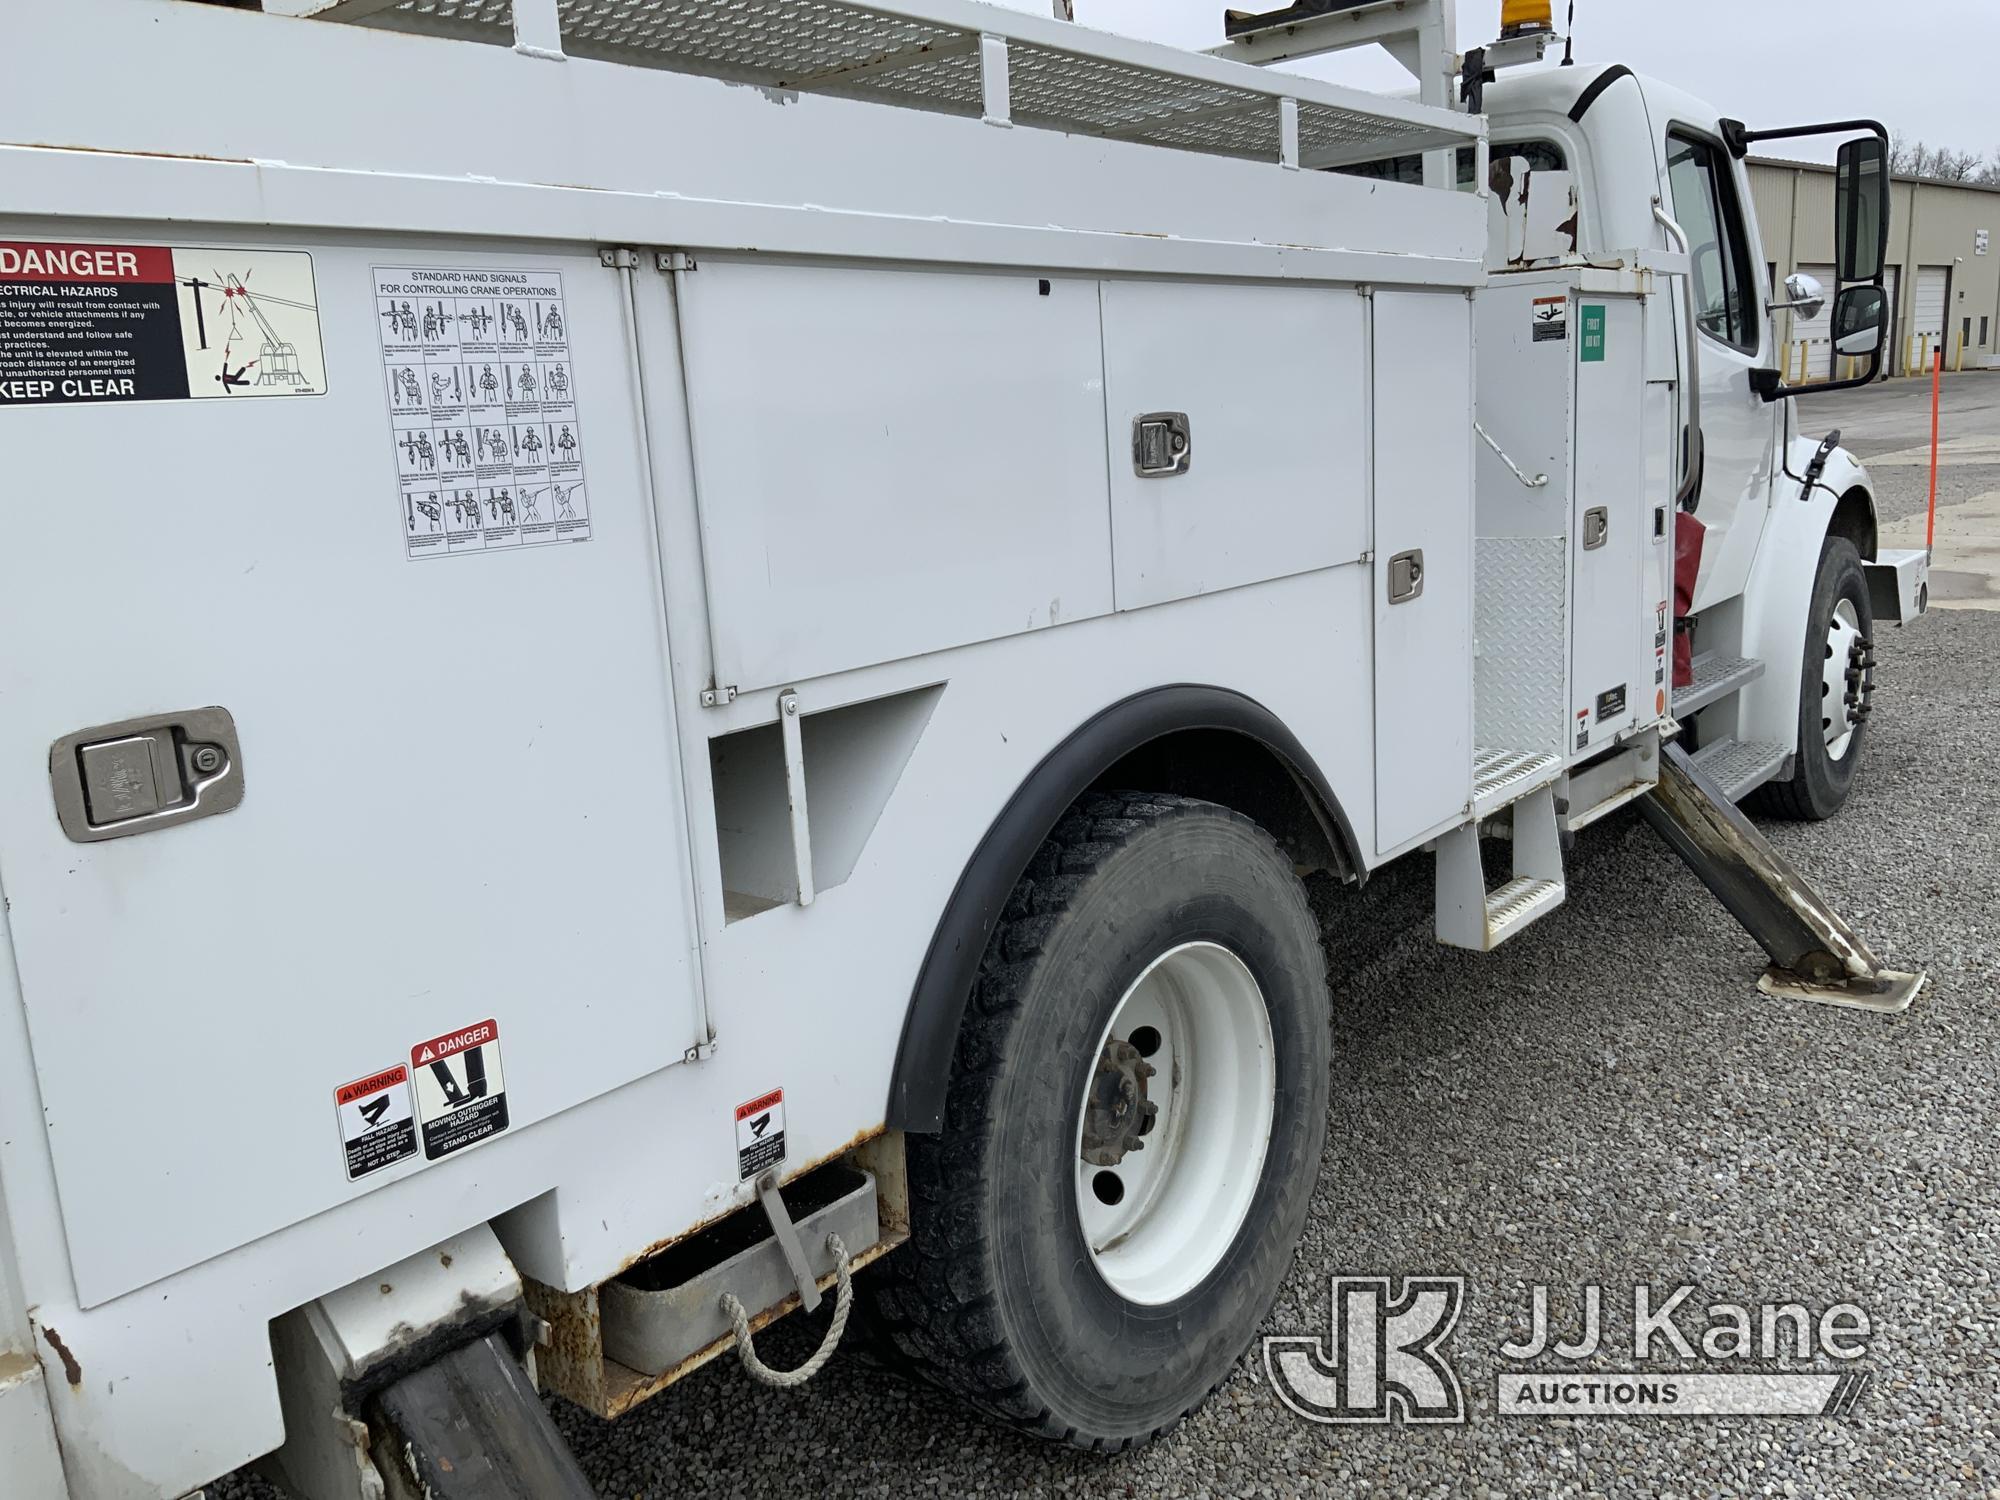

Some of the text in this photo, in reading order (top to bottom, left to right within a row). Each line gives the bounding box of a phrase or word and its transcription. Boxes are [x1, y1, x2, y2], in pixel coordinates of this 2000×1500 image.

[0, 248, 139, 276] DANGER
[411, 272, 527, 283] STANDARD HAND SIGNALS
[60, 286, 118, 297] HAZARDS
[380, 284, 557, 296] FOR CONTROLLING CRANE OPERATIONS
[9, 301, 36, 310] injury
[39, 301, 55, 309] will
[57, 301, 84, 309] result
[86, 301, 106, 309] from
[31, 310, 63, 318] vehicle
[65, 311, 120, 319] attachments
[130, 312, 145, 320] any
[48, 320, 95, 329] energized.
[13, 331, 65, 339] understand
[67, 331, 84, 339] and
[86, 331, 112, 339] follow
[114, 331, 133, 339] safe
[4, 341, 50, 351] practices.
[46, 350, 84, 358] elevated
[27, 360, 67, 368] distance
[68, 359, 77, 367] of
[93, 358, 136, 368] energized
[5, 369, 66, 377] unauthorized
[68, 368, 112, 378] personnel
[0, 379, 135, 399] KEEP CLEAR
[438, 1026, 490, 1055] DANGER
[352, 1070, 403, 1096] WARNING
[746, 1093, 779, 1114] WARNING
[428, 1097, 499, 1130] MOVING OUTRIGGER
[450, 1112, 480, 1128] HAZARD
[361, 1124, 399, 1142] FALL HAZARD
[443, 1135, 467, 1150] STAND
[468, 1124, 493, 1139] CLEAR
[347, 1146, 361, 1155] Death
[387, 1131, 400, 1140] injury
[367, 1157, 379, 1167] NOT
[386, 1149, 401, 1160] STEP
